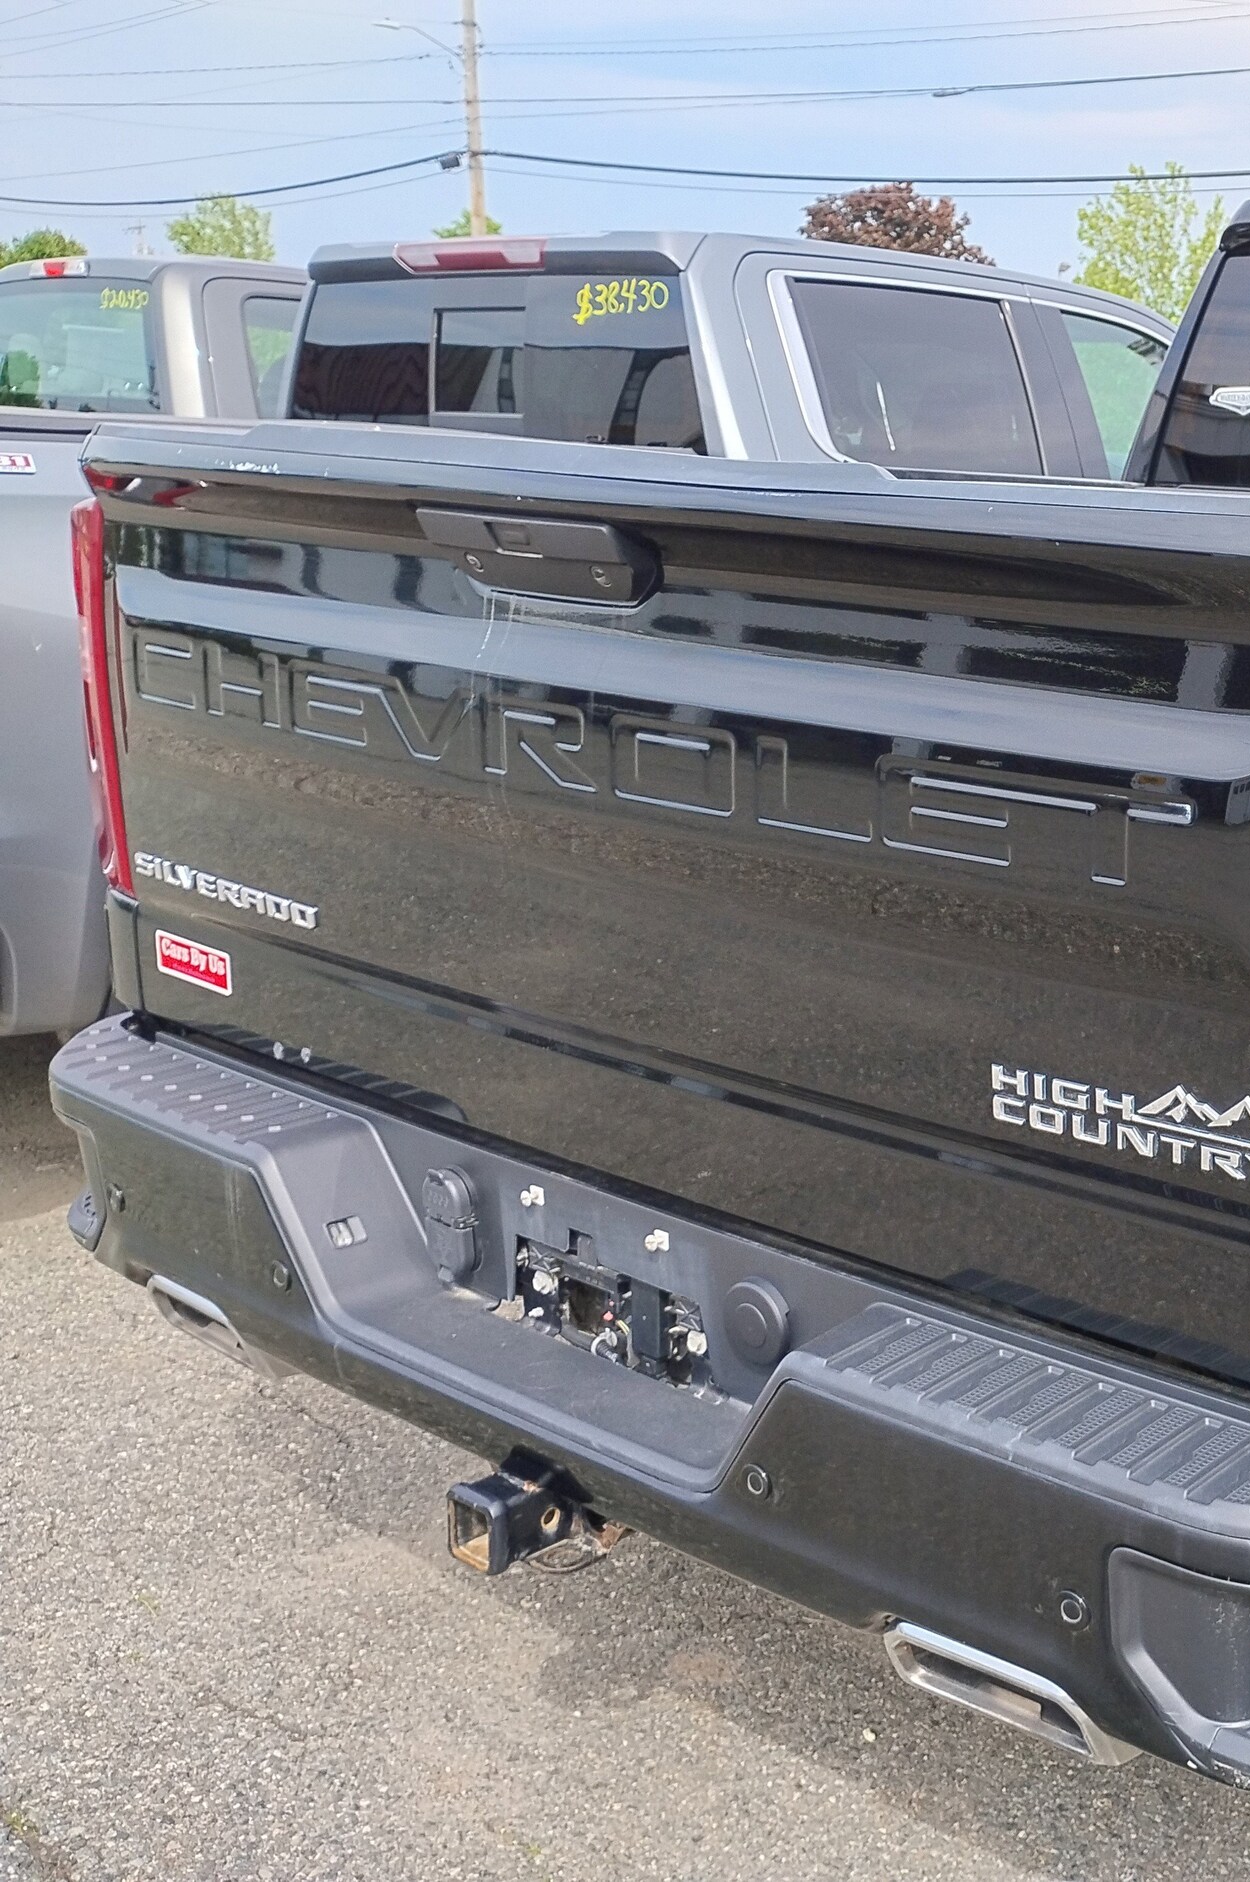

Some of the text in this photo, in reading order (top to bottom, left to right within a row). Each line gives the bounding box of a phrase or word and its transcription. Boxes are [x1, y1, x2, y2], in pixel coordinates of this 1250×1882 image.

[572, 278, 669, 325] $38,430
[133, 626, 1198, 887] CHEVROLET
[134, 850, 319, 930] SILVERADO
[161, 937, 190, 963] Cars
[991, 1063, 1136, 1121] HIGH
